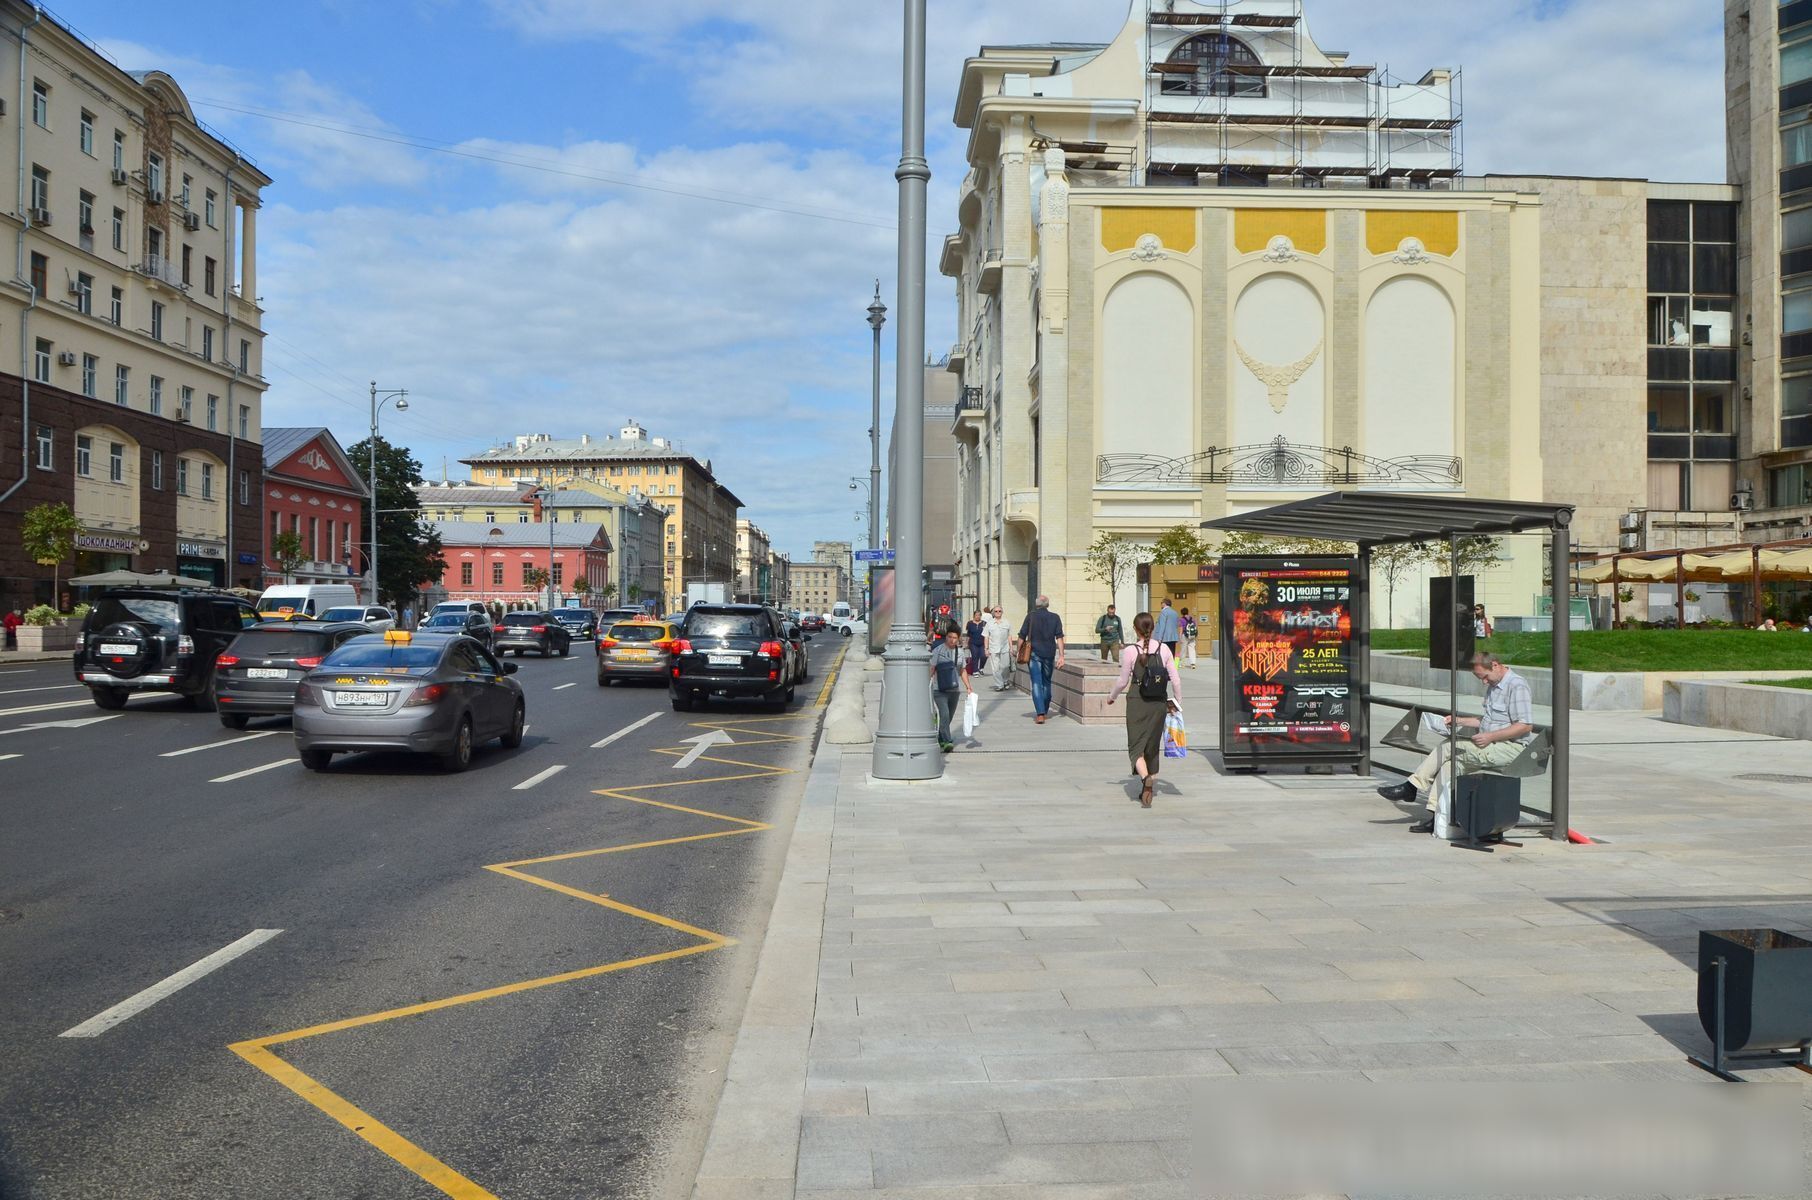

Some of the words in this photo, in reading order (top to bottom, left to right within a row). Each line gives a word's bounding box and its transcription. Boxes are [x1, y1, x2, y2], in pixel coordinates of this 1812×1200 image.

[77, 535, 136, 551] ШОКОЛАДНИЦА
[180, 543, 202, 556] PRIME
[1277, 586, 1296, 602] 30
[1296, 586, 1321, 596] ИЮЛЯ
[1302, 648, 1316, 658] 25
[1317, 648, 1339, 658] ЛЕТ!
[1243, 684, 1284, 695] KRUIZ
[338, 693, 371, 702] Н893НН
